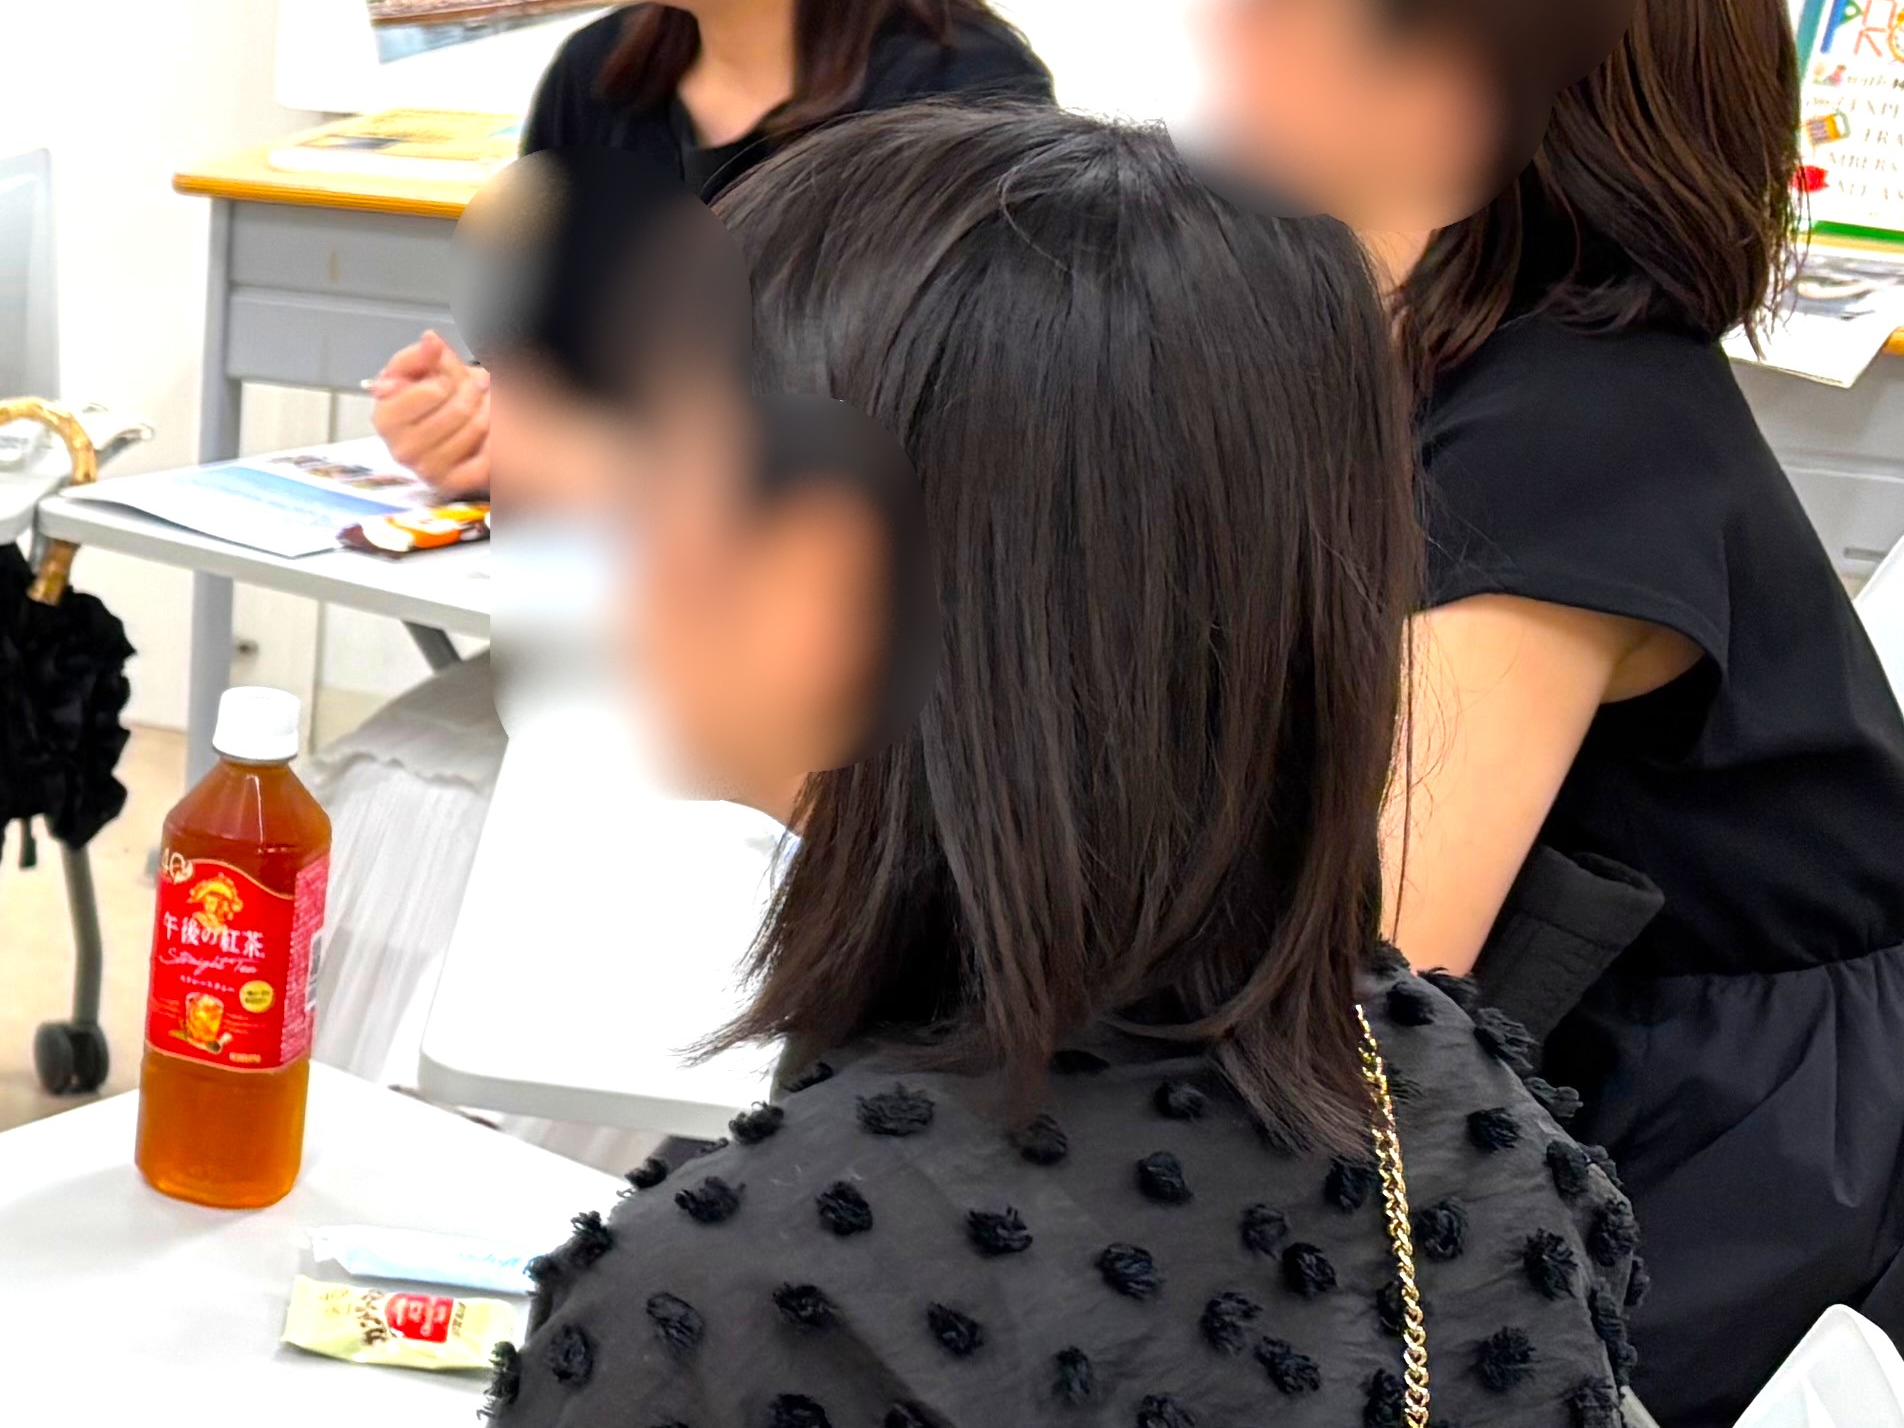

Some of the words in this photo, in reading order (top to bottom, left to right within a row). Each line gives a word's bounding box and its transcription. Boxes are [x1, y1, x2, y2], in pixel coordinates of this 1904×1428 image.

[162, 910, 266, 959] 午後の紅茶
